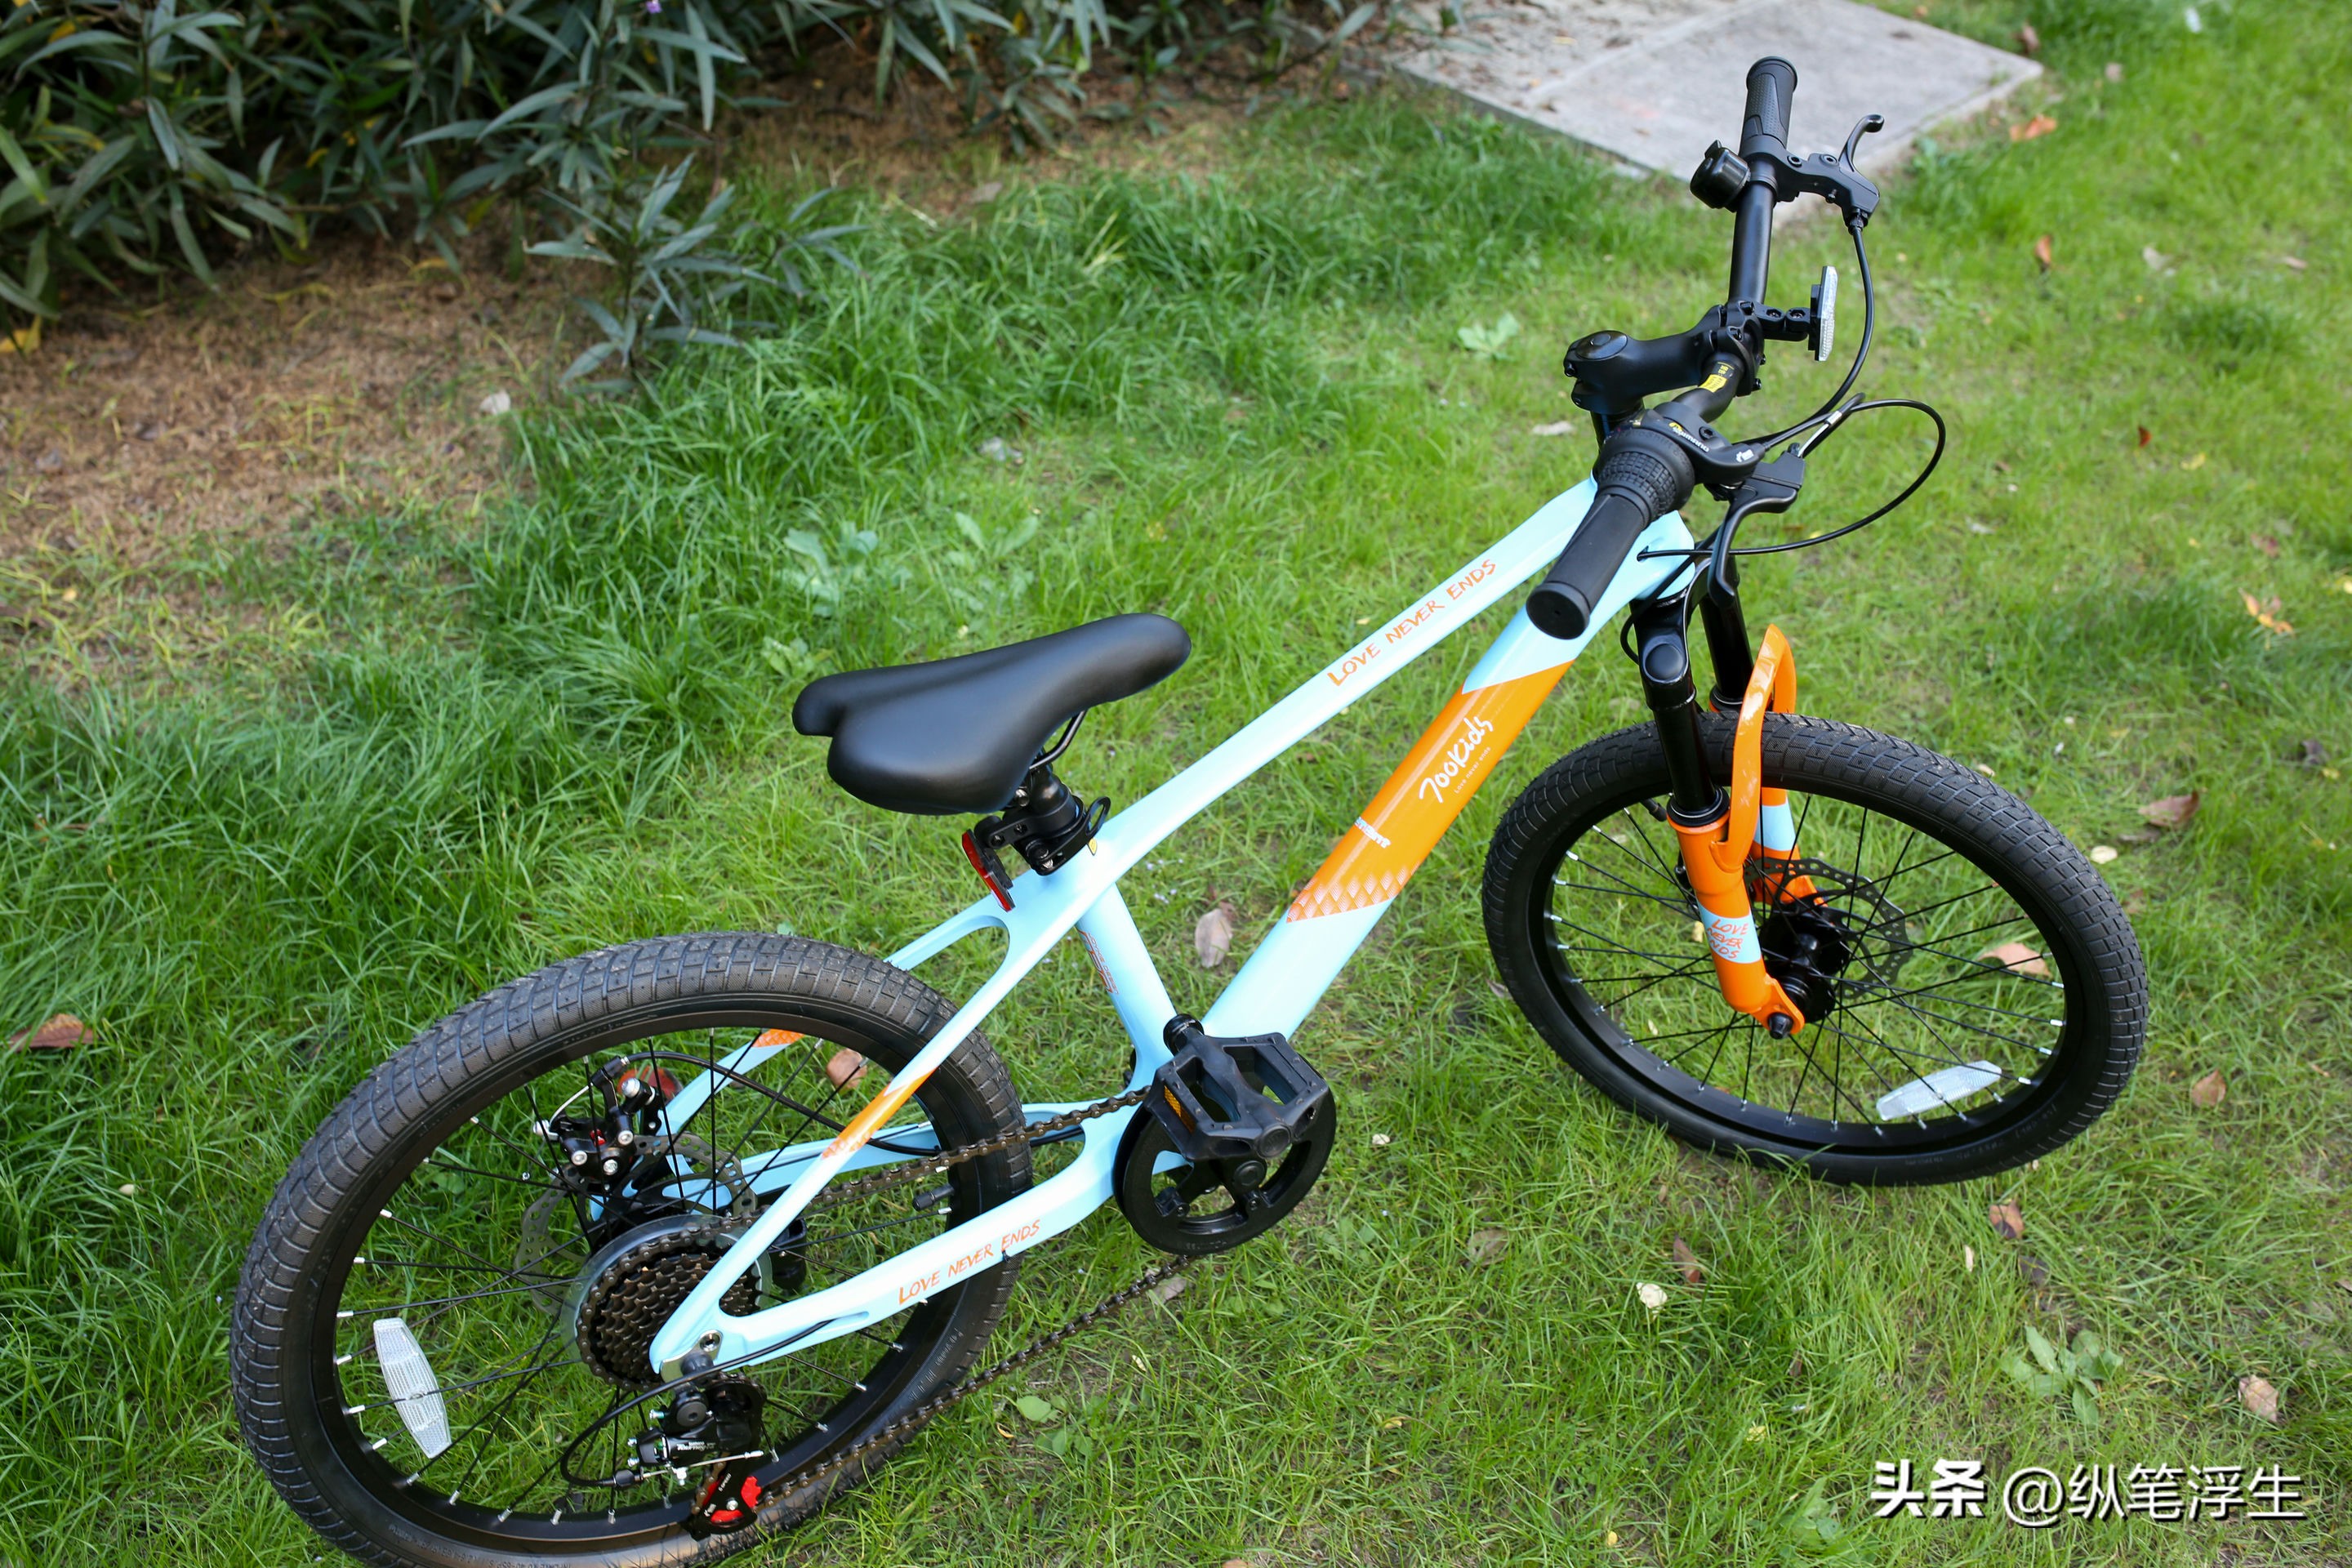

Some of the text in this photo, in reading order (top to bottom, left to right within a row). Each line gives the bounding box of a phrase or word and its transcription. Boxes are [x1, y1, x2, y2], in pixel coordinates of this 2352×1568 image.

[1327, 559, 1497, 686] LOVE NEVER ENDS
[1707, 928, 1744, 949] NEVER
[1711, 919, 1749, 935] LOVE
[898, 1218, 1040, 1306] LOVE NEVER ENDS
